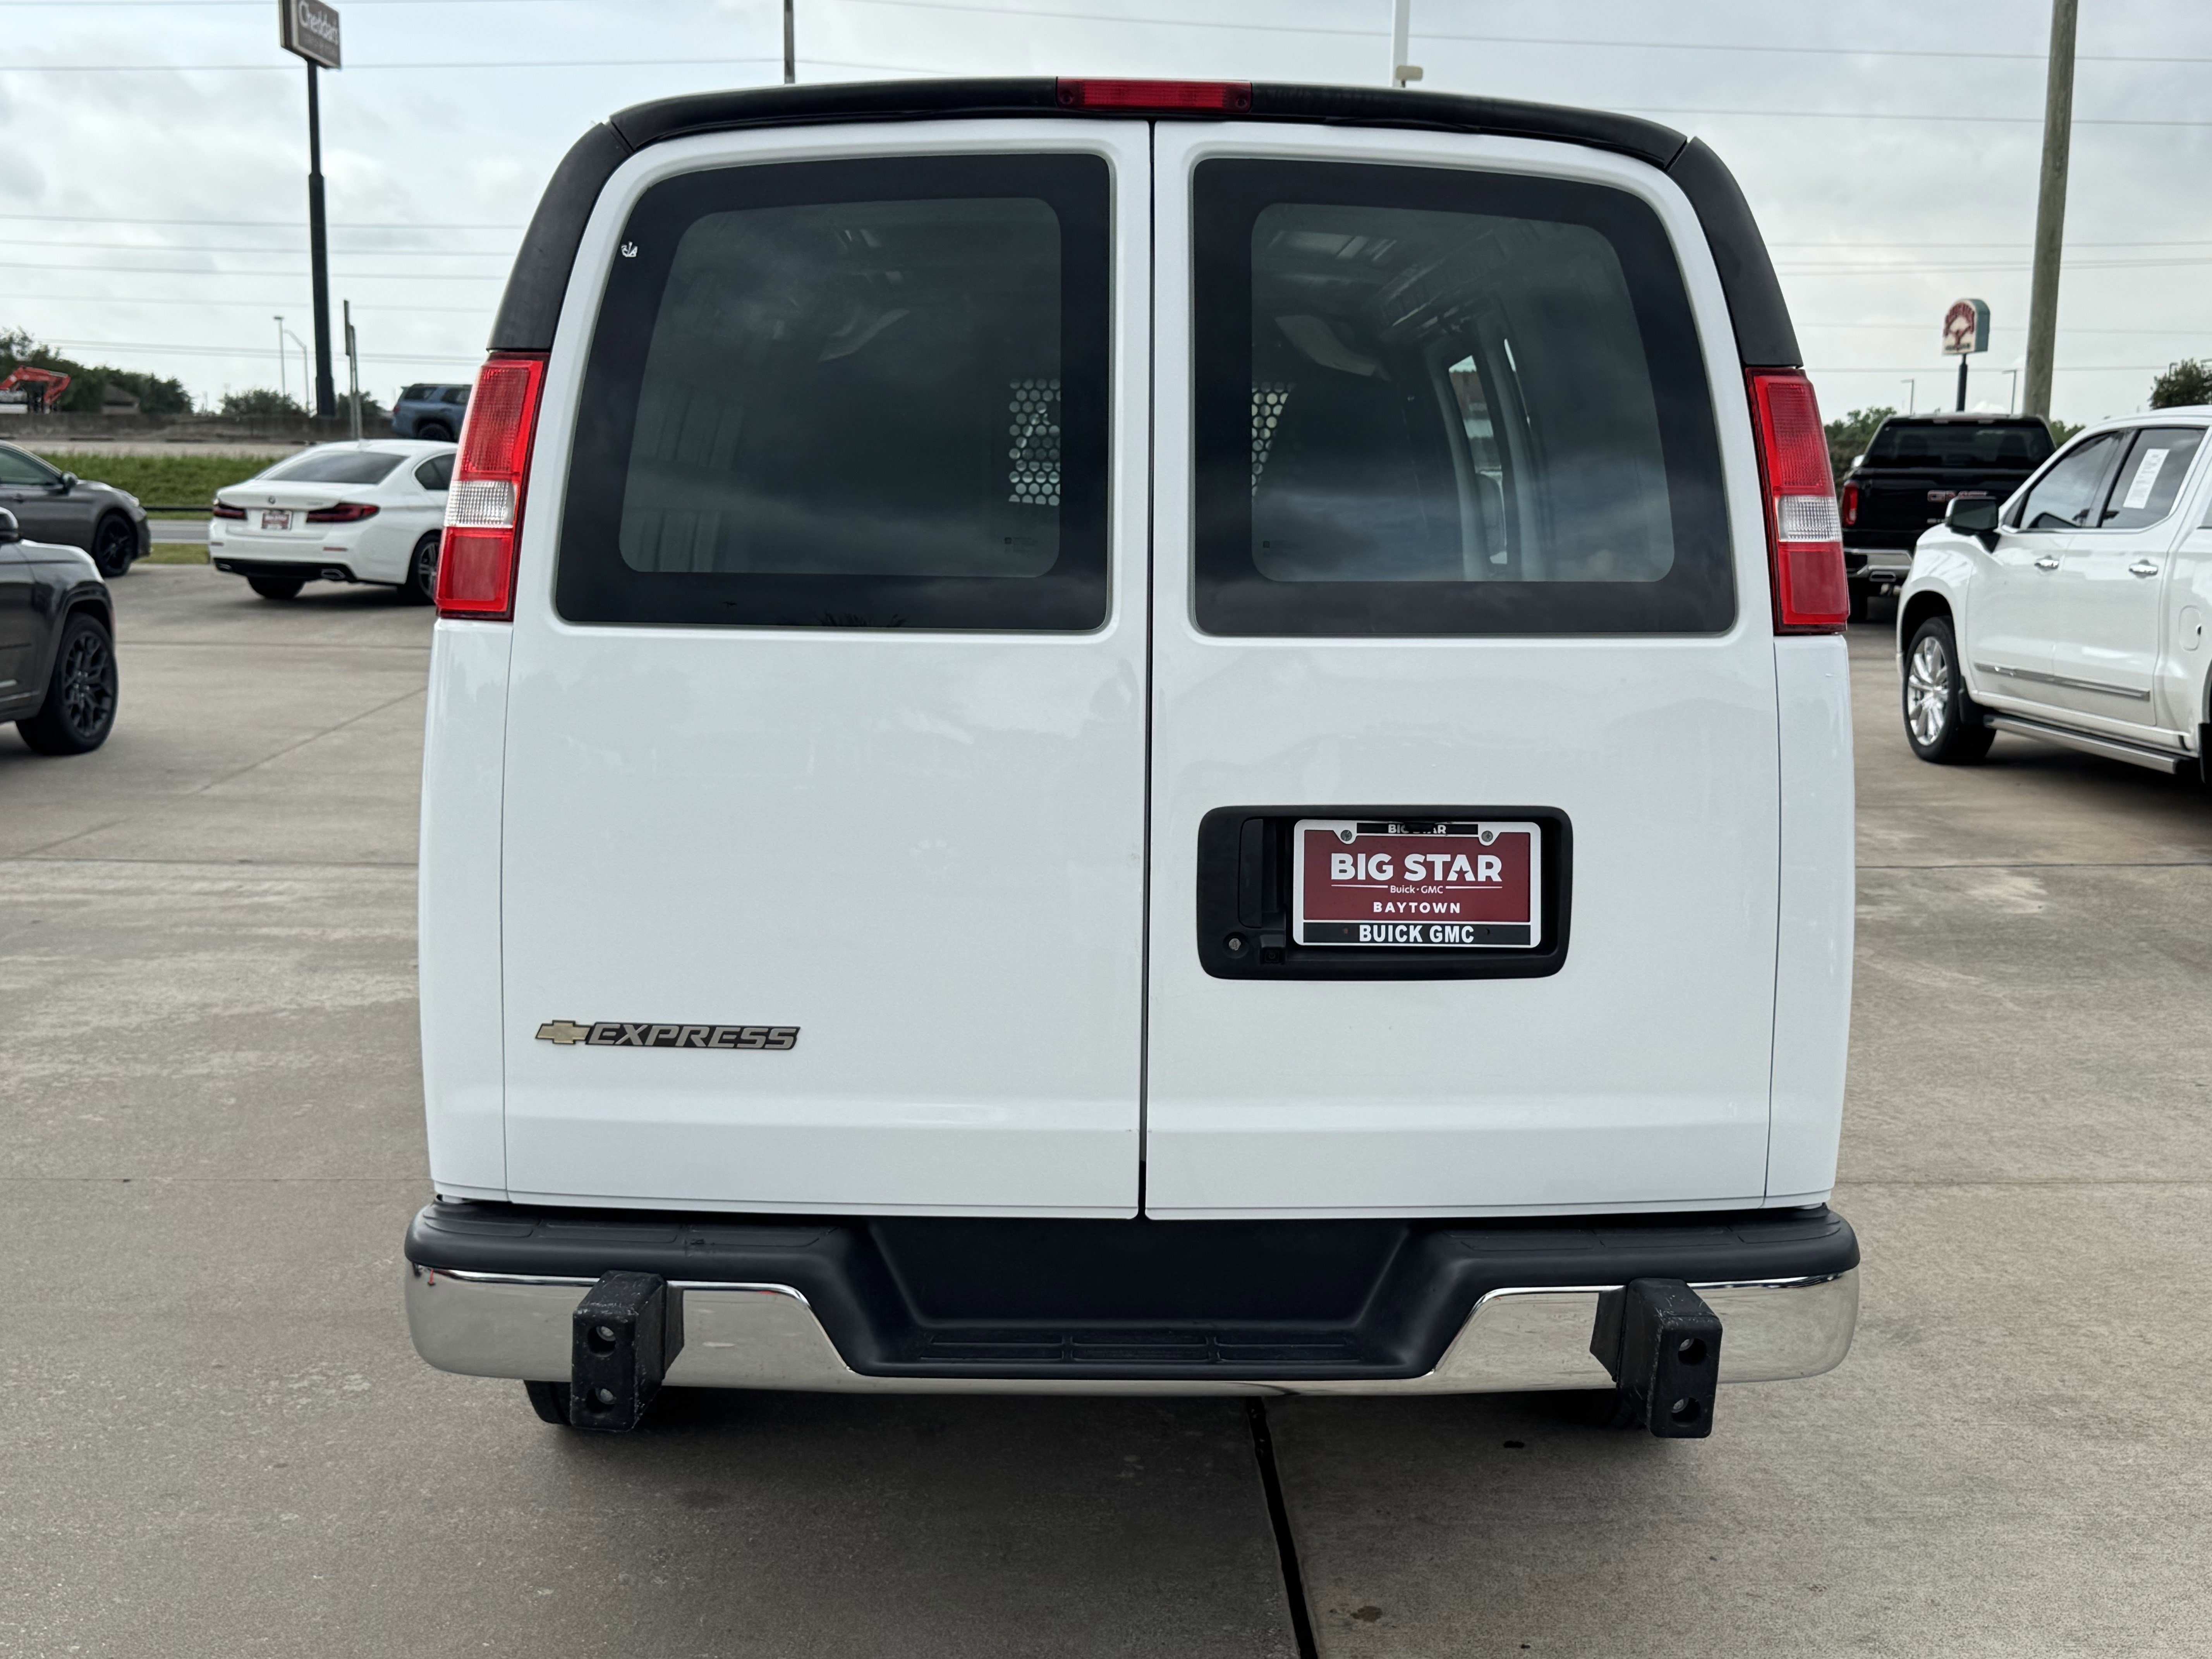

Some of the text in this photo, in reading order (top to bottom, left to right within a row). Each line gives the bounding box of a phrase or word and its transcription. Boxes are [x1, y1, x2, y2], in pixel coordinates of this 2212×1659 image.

[1331, 853, 1503, 882] BIG STAR
[1390, 885, 1443, 894] Buick GMC
[1373, 902, 1460, 914] BAYTOWN
[1359, 924, 1474, 943] BUICK GMC
[587, 1024, 797, 1049] EXPRESS
